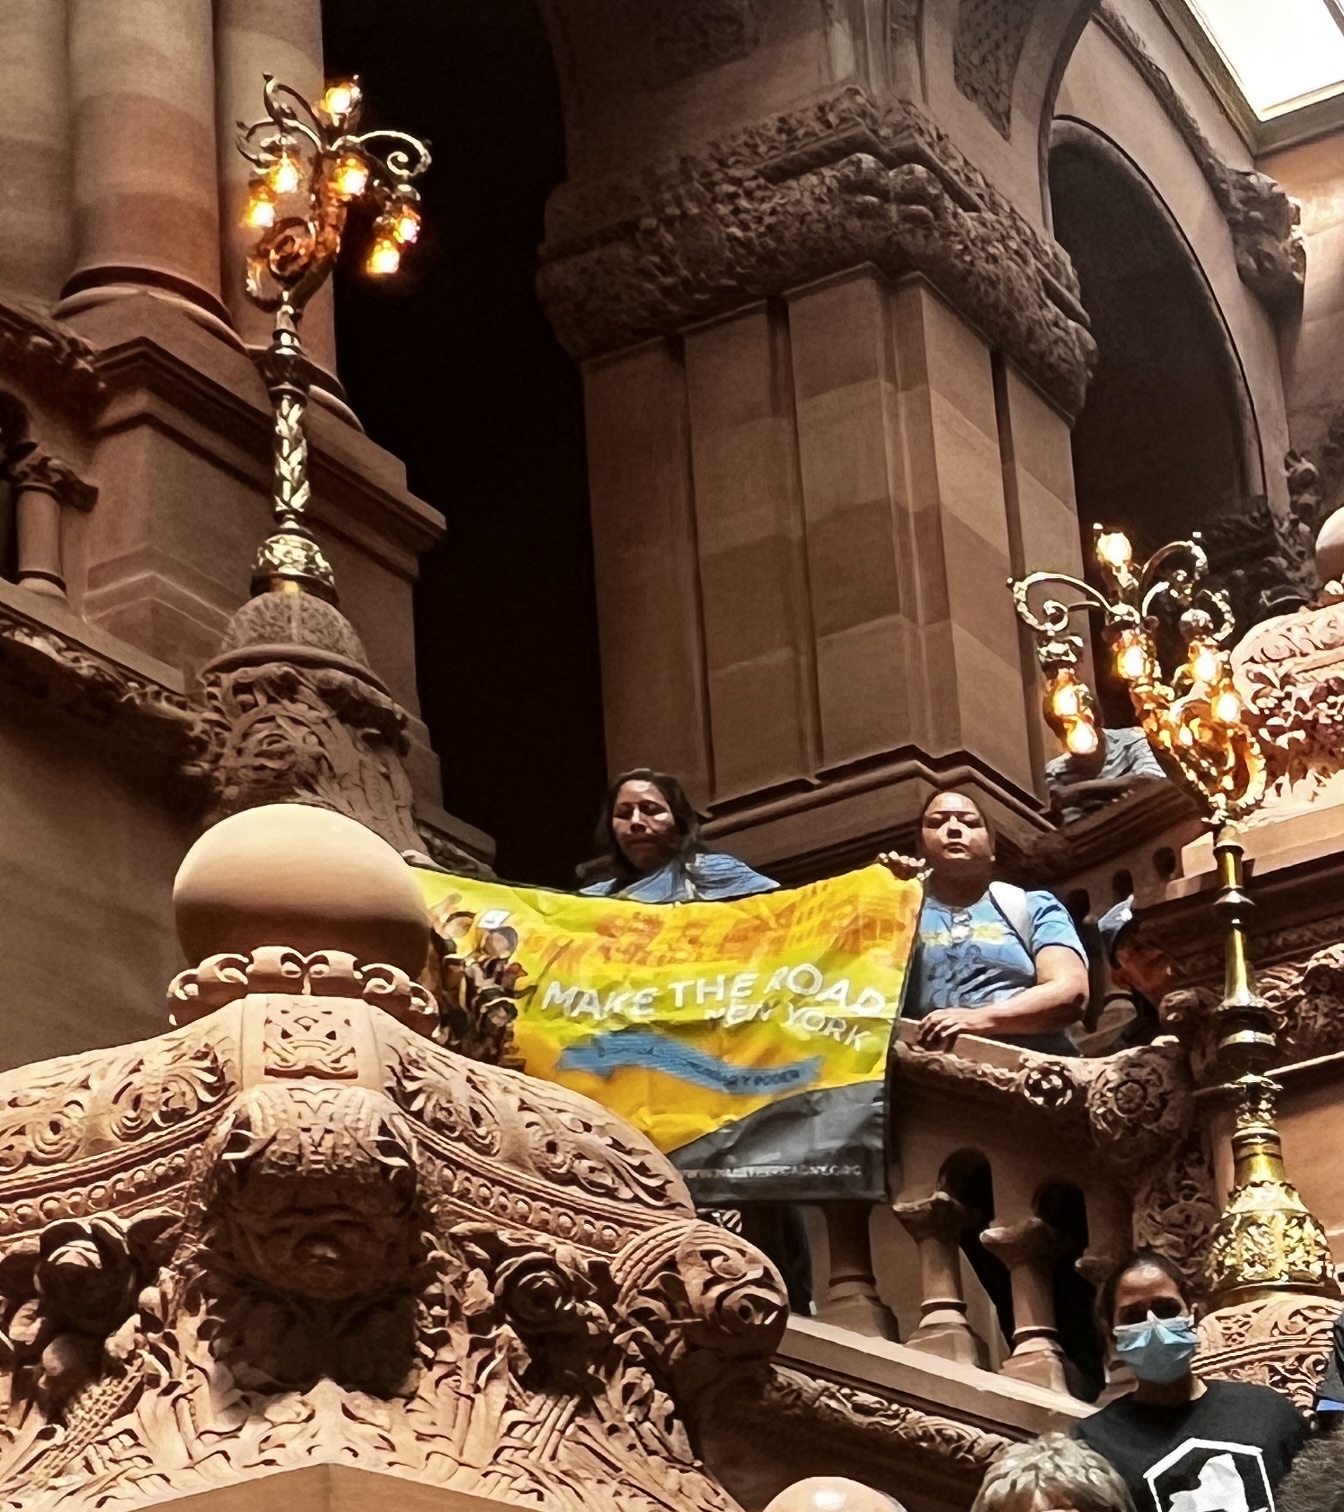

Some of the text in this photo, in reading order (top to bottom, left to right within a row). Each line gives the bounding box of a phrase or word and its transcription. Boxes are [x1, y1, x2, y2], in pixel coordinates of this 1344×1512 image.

[542, 962, 887, 1020] MAKE THE ROAD
[785, 1003, 875, 1052] YORK
